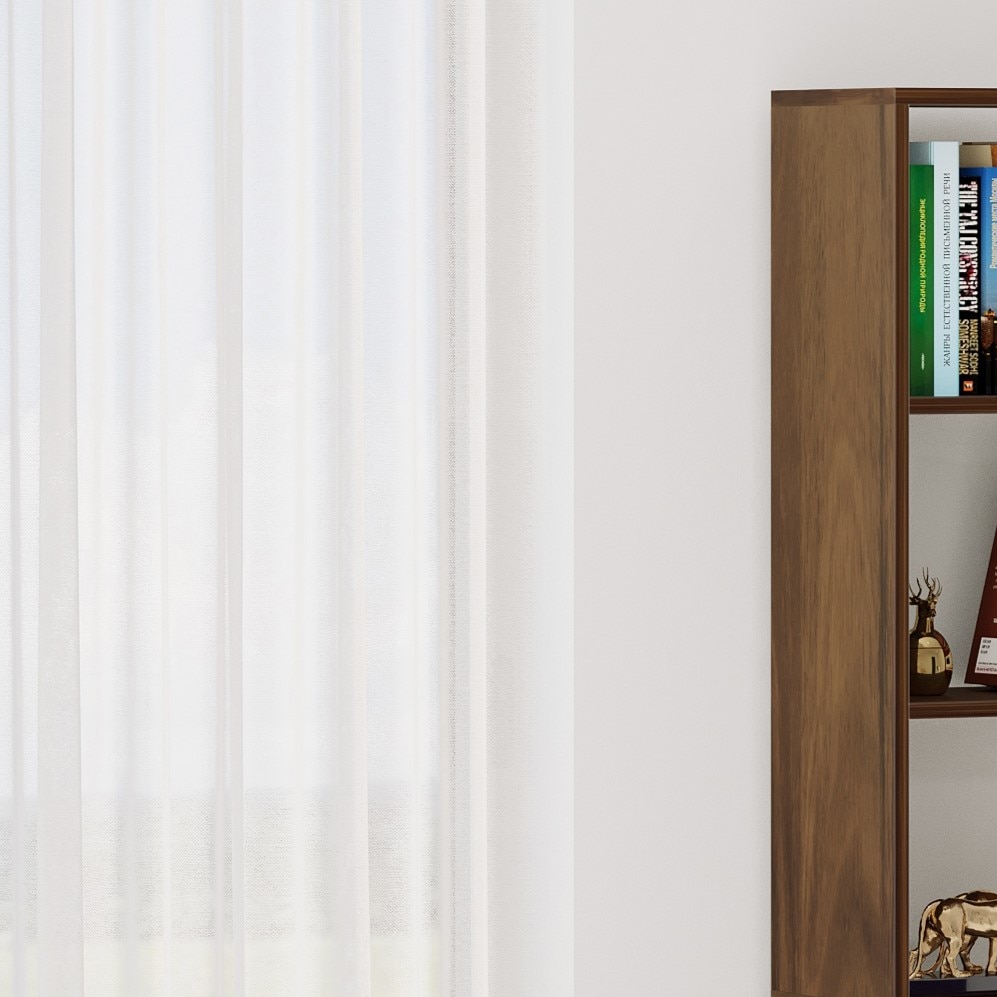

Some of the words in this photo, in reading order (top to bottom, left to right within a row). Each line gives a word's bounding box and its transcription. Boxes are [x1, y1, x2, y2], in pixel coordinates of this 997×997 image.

[943, 173, 951, 194] РЕЧИ
[959, 181, 978, 207] THE
[943, 199, 951, 259] ПИСЬМЕННОЙ
[959, 210, 978, 235] TAJ
[942, 264, 951, 330] ЕСТЕСТВЕННОЙ
[959, 318, 969, 375] SOMESHWAR
[969, 318, 978, 348] MANREET
[943, 334, 951, 366] ЖАНРЫ
[969, 350, 978, 375] SODHI
